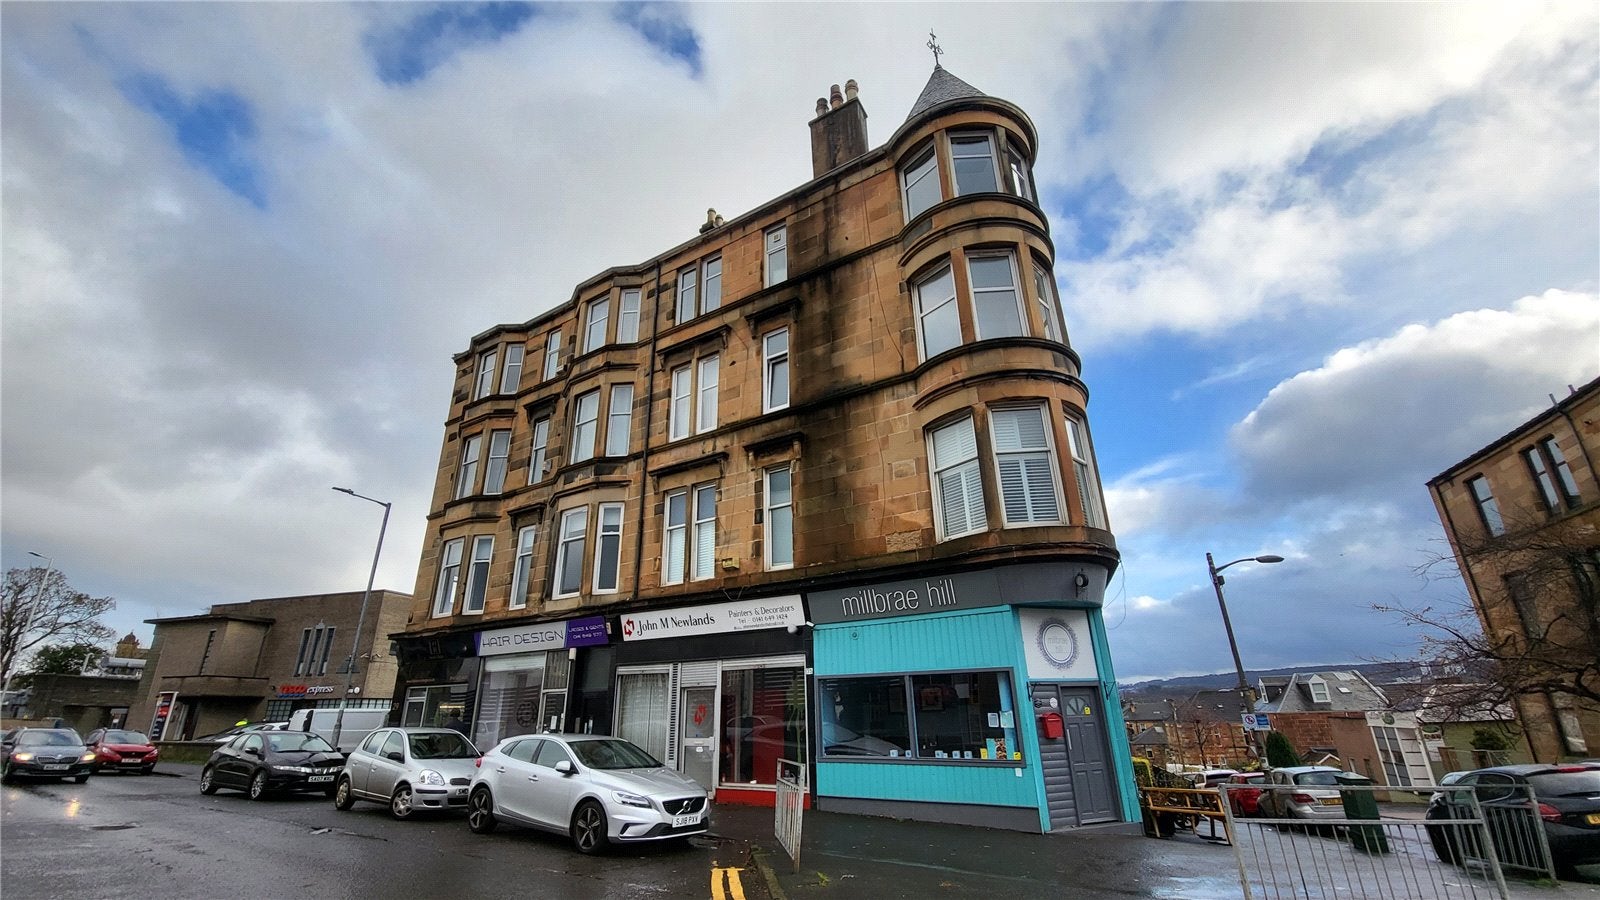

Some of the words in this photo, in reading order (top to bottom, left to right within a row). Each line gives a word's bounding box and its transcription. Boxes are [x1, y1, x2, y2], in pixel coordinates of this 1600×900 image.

[842, 588, 919, 616] millbrae
[926, 579, 956, 607] hill
[728, 609, 753, 618] Painters
[754, 607, 760, 616] &
[760, 605, 795, 615] Decorators
[637, 619, 658, 636] John
[660, 617, 669, 629] M
[670, 612, 716, 628] Newlands
[482, 636, 511, 647] HAIR
[514, 630, 564, 645] DESIGN
[306, 685, 335, 696] express
